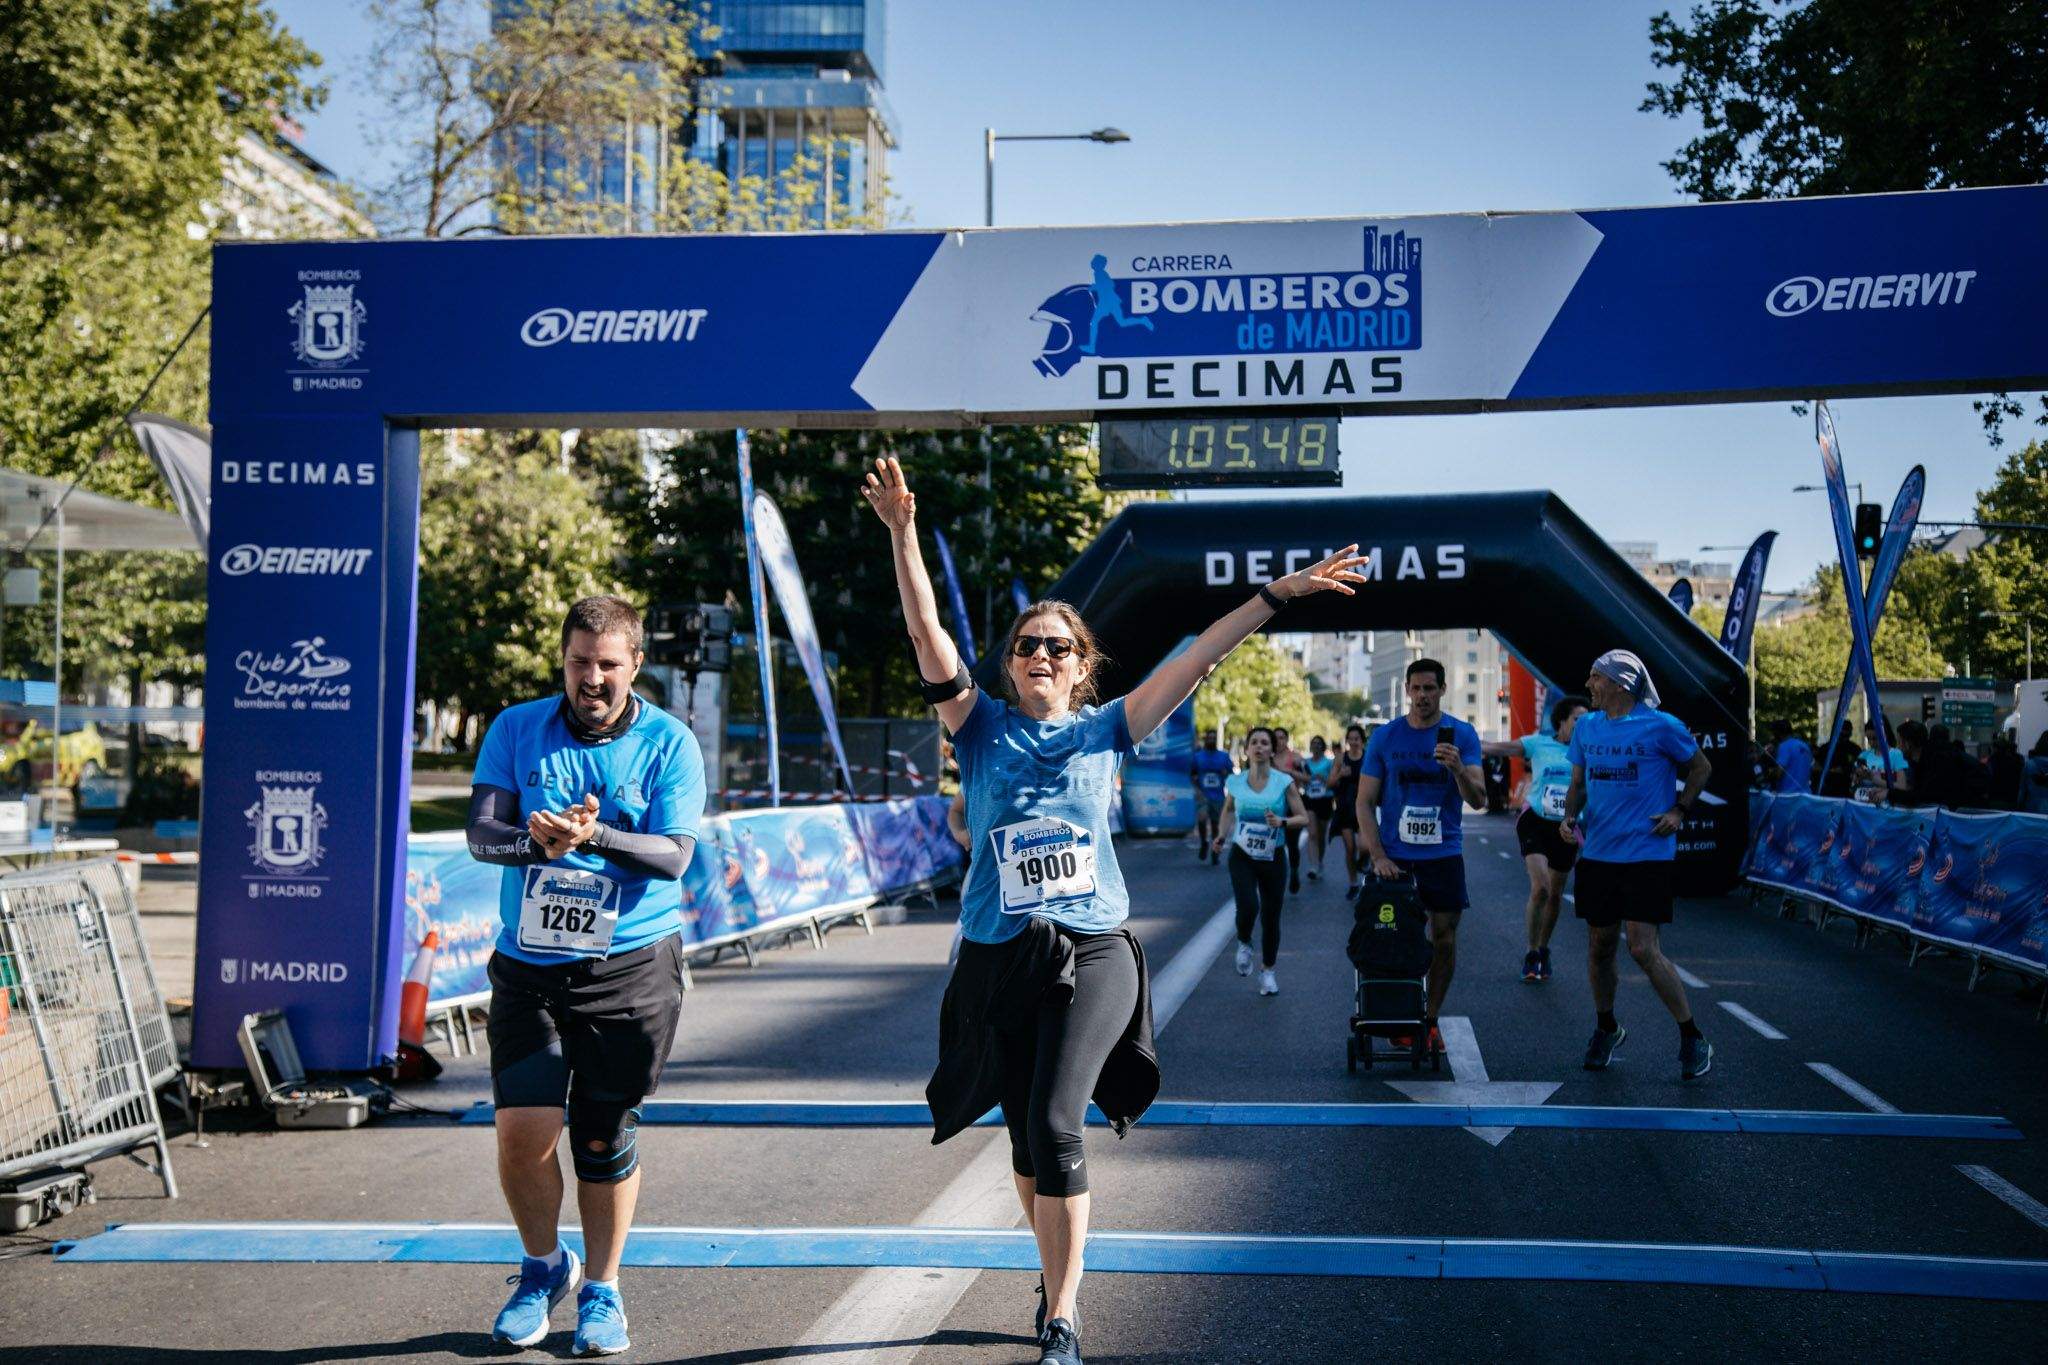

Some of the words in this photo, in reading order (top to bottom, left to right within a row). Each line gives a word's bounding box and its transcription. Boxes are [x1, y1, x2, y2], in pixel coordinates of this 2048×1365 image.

[1132, 255, 1233, 272] CARRERA
[298, 269, 362, 281] BOMBEROS
[1131, 272, 1410, 315] BOMBEROS
[1822, 270, 1977, 311] ENERVIT
[570, 309, 707, 342] ENERVIT
[1238, 315, 1274, 350] de
[1285, 309, 1411, 350] MADRID
[309, 377, 363, 390] MADRID
[1098, 356, 1403, 400] DECIMAS
[221, 461, 376, 486] DECIMAS
[260, 547, 373, 576] ENERVIT
[235, 650, 287, 675] Club
[245, 669, 351, 700] Deportivo
[291, 697, 308, 710] de
[311, 697, 351, 710] madrid
[256, 770, 322, 783] BOMBEROS
[1023, 827, 1072, 842] BOMBEROS
[1406, 822, 1436, 836] 1992
[1021, 842, 1073, 858] DECIMAS
[1246, 837, 1267, 850] 326
[1016, 852, 1077, 887] 1900
[265, 884, 322, 898] MADRID
[548, 894, 598, 908] DECIMAS
[540, 904, 597, 935] 1262
[250, 961, 349, 983] MADRID
